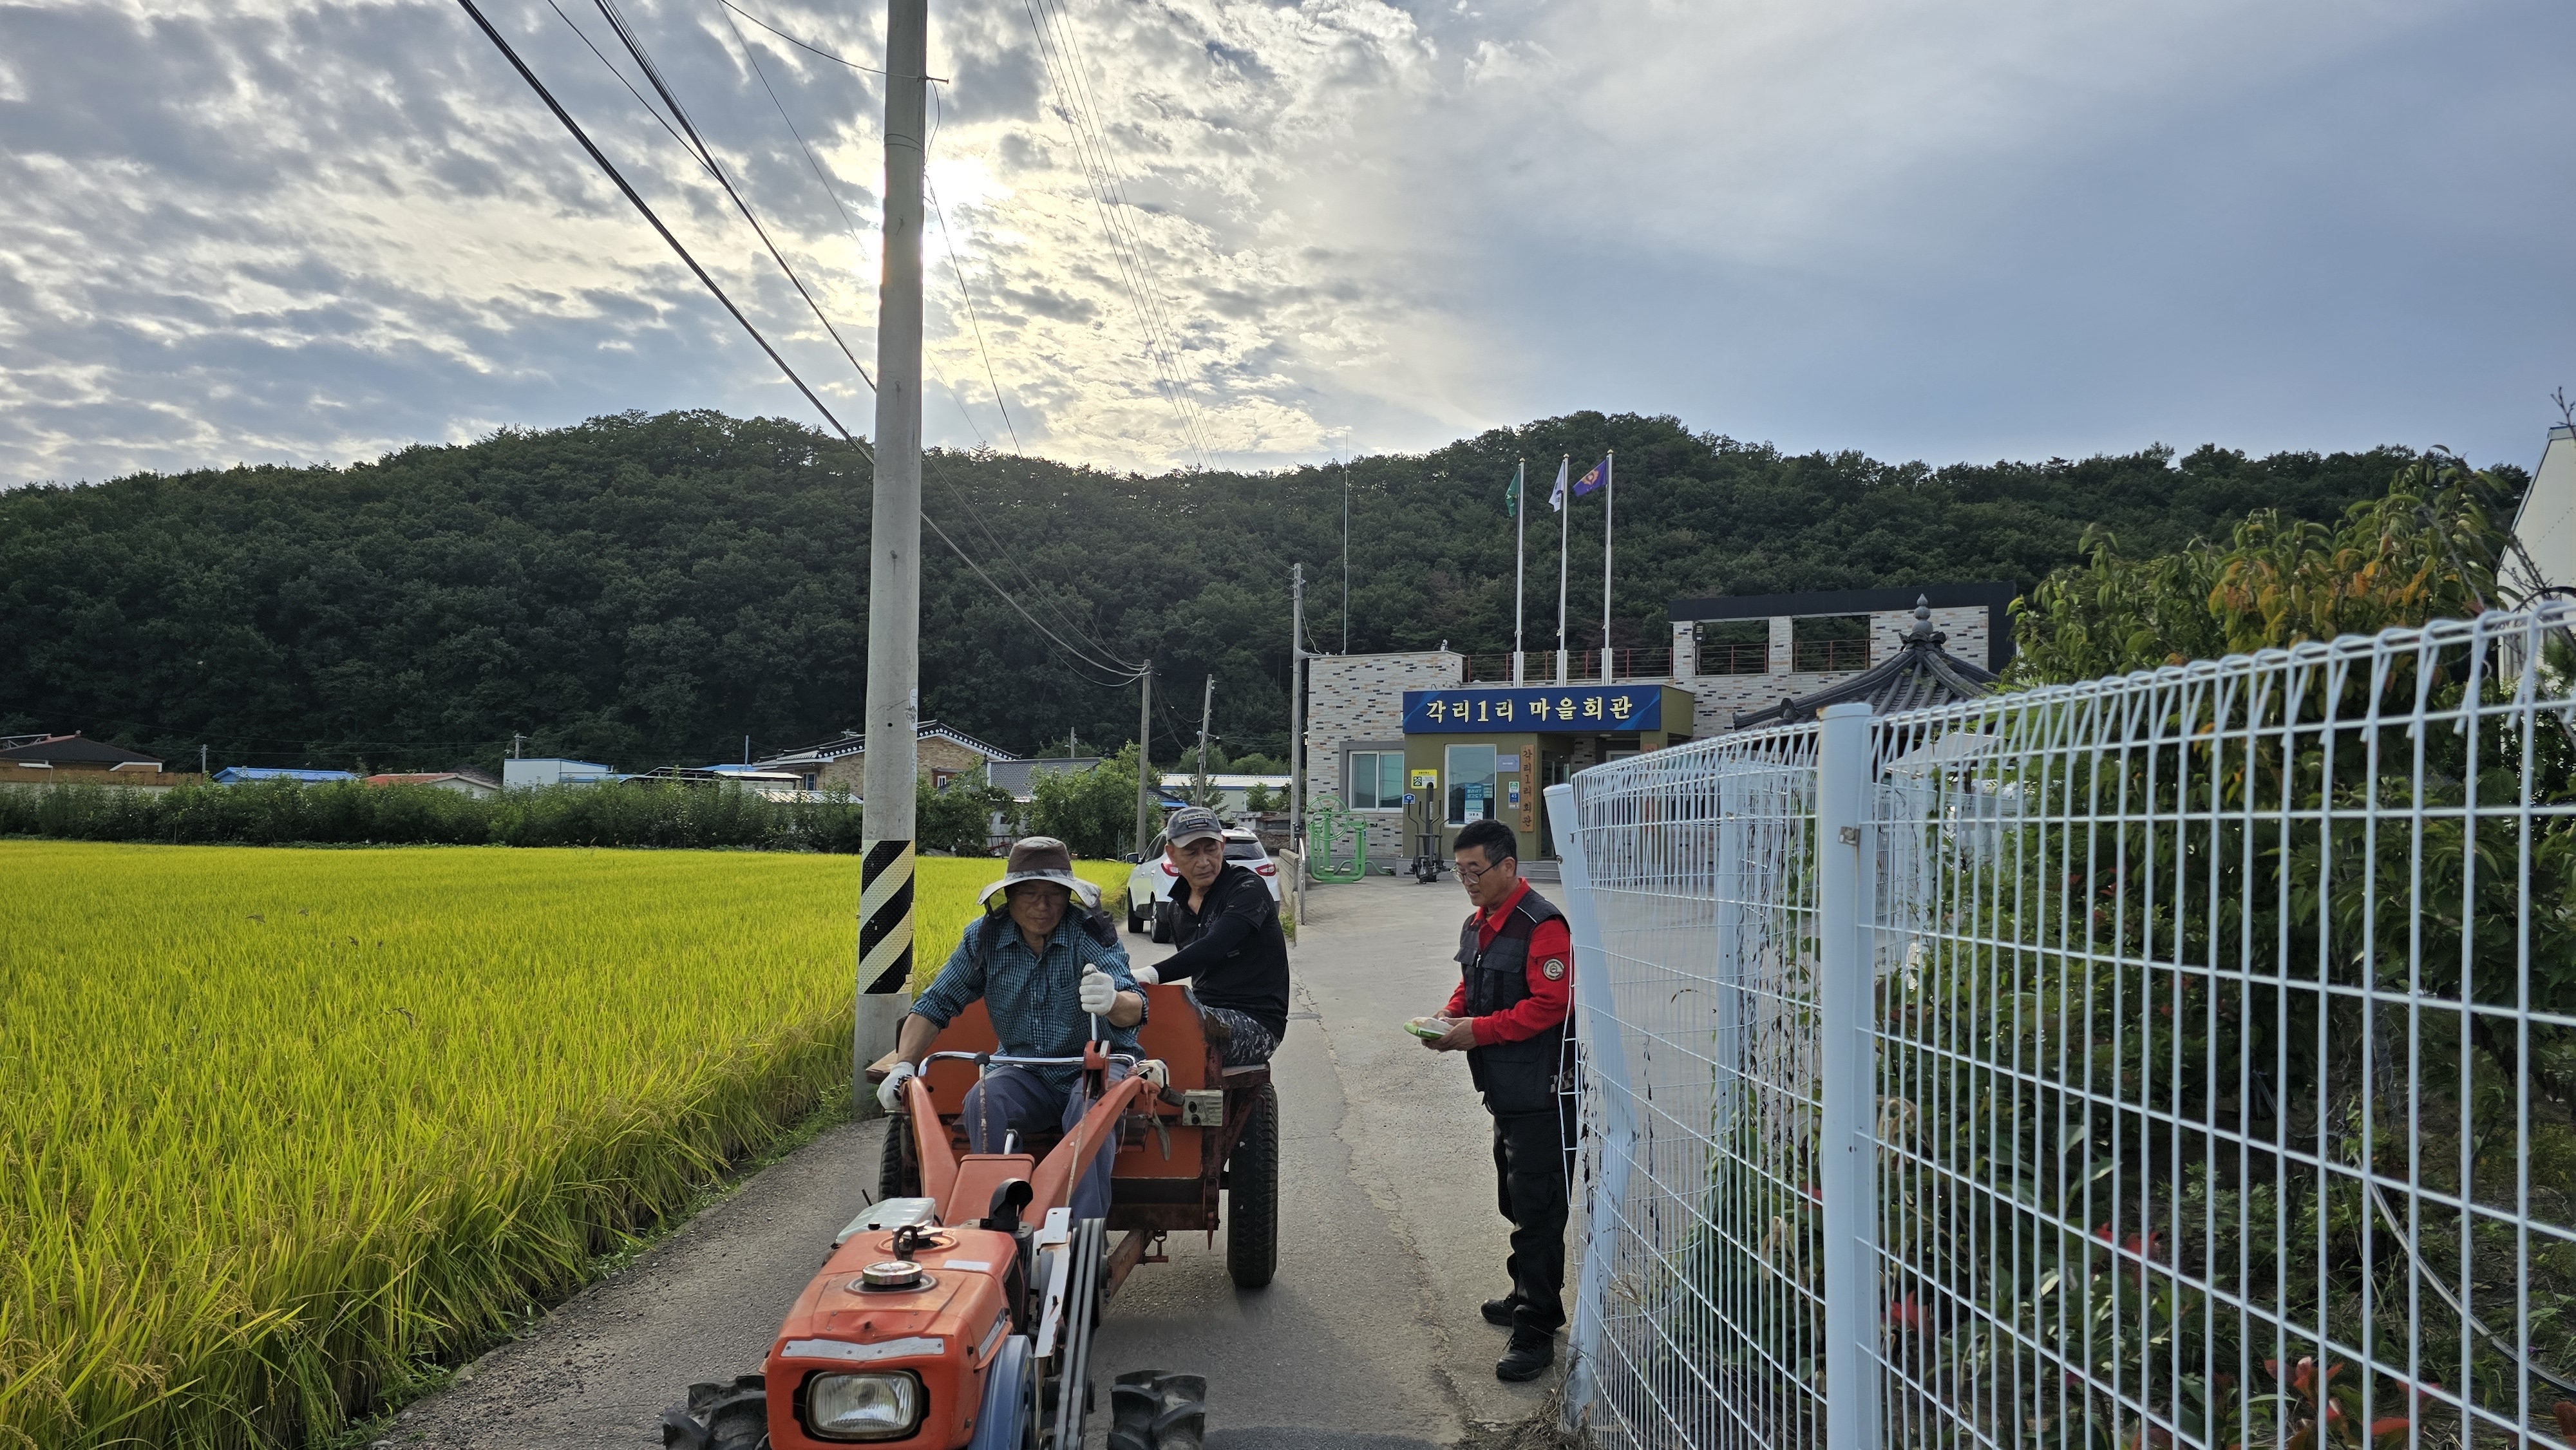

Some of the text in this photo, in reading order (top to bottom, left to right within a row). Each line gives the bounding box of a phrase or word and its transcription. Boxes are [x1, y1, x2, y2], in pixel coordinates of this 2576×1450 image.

[1426, 695, 1633, 723] 각리1리 마을회관
[1522, 749, 1533, 827] 각리1리 회관
